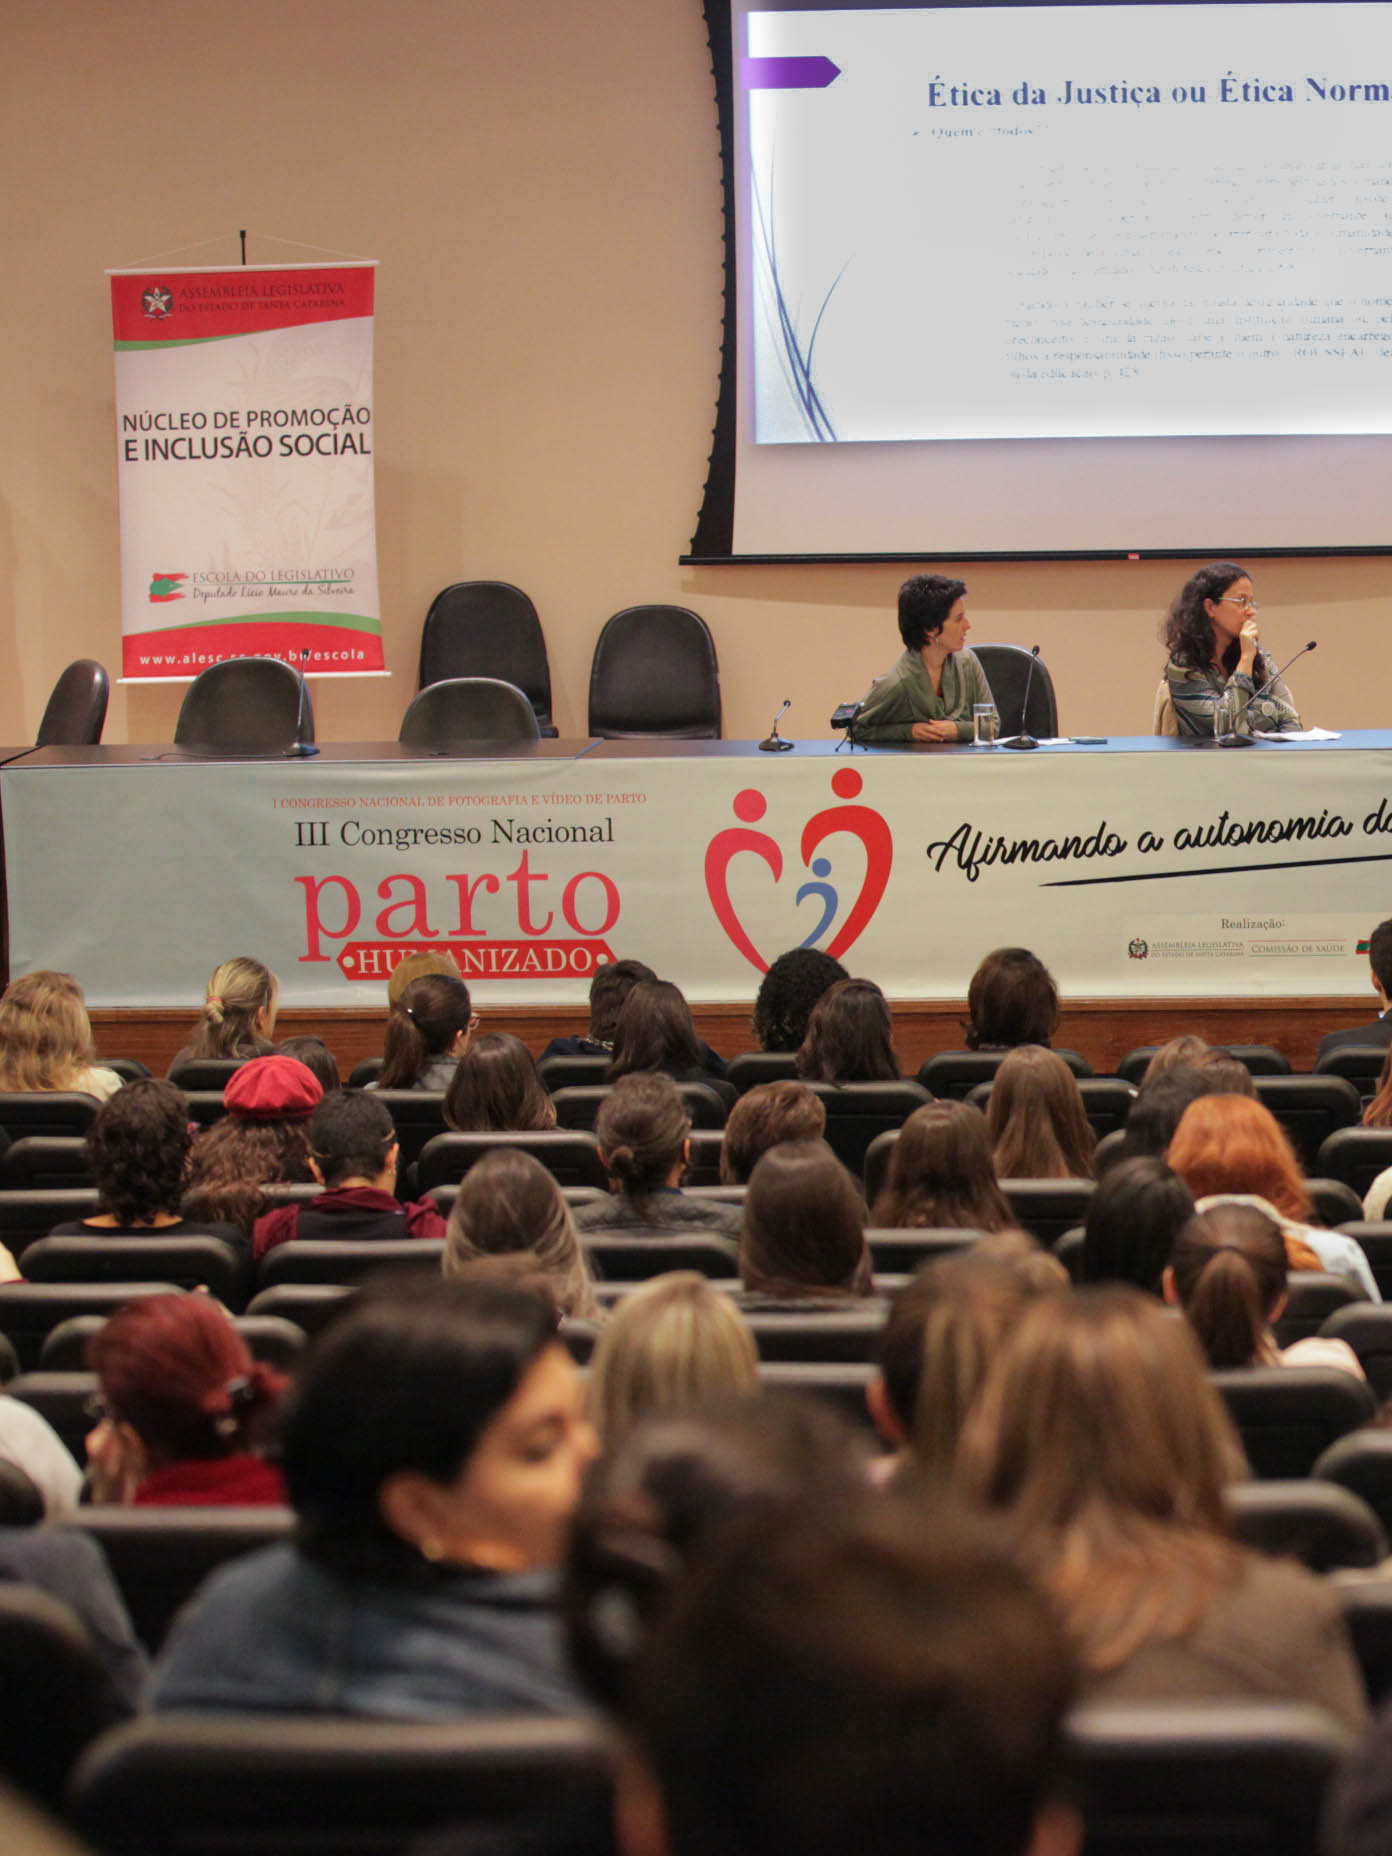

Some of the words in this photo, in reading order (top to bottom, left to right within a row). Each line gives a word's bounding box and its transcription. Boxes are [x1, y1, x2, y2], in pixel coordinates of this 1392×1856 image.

[927, 75, 1002, 107] Ética
[1012, 80, 1046, 106] da
[1057, 79, 1161, 109] Justiça
[1171, 83, 1207, 104] ou
[1220, 71, 1294, 104] Ética
[122, 410, 208, 432] NÚCLEO
[213, 411, 241, 430] DE
[246, 404, 371, 431] PROMOÇÃO
[124, 438, 138, 462] E
[144, 431, 273, 461] INCLUSÃO
[279, 432, 371, 457] SOCIAL
[193, 571, 240, 584] ESCOLA
[245, 570, 266, 582] DO
[271, 567, 355, 581] LEGISLATIVO
[273, 798, 277, 809] I
[280, 797, 356, 809] CONGRESSO
[359, 796, 425, 808] NACIONAL
[428, 795, 444, 807] DE
[448, 795, 528, 807] FOTOGRAFIA
[531, 794, 541, 805] E
[543, 792, 582, 805] VÍDEO
[585, 793, 602, 805] DE
[606, 792, 648, 804] PARTO
[294, 821, 329, 846] III
[340, 819, 482, 851] Congresso
[491, 817, 616, 844] Nacional
[926, 820, 1128, 882] Afirmando
[1137, 831, 1164, 853] a
[1173, 809, 1354, 851] autonomia
[294, 849, 621, 963] parto
[1302, 943, 1314, 953] DE
